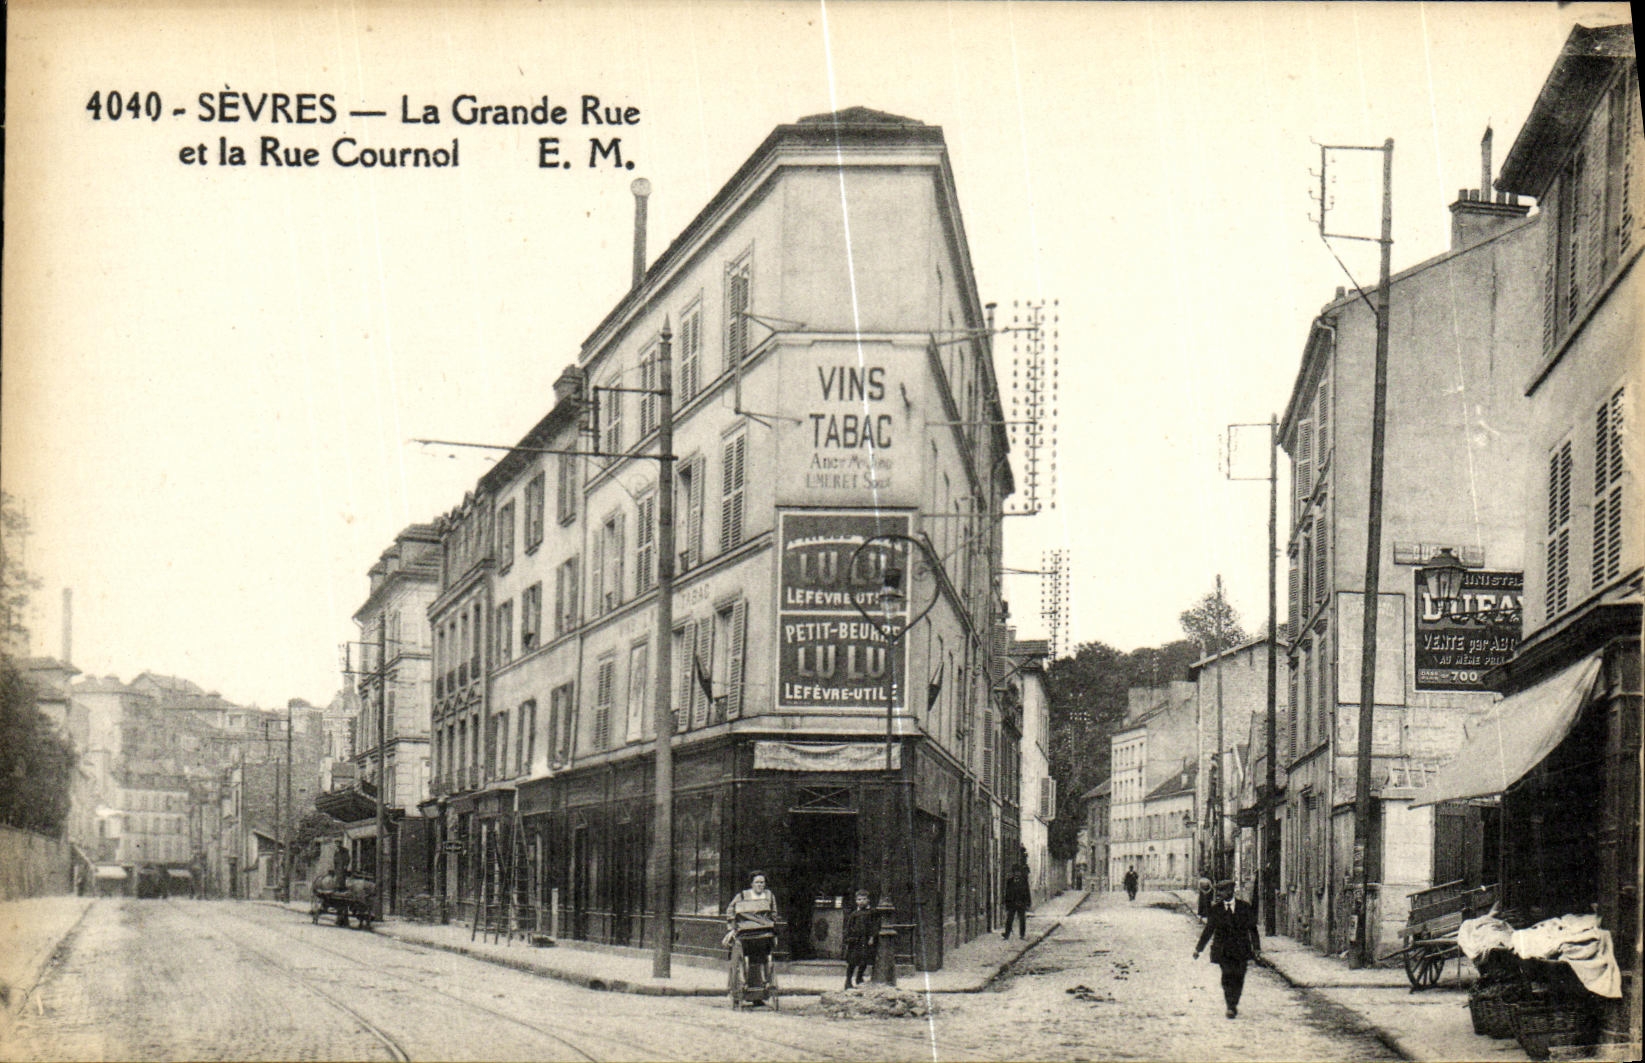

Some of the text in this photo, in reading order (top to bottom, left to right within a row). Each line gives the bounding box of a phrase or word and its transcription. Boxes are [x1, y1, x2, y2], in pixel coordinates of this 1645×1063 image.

[818, 366, 885, 401] VINS
[809, 413, 892, 449] TABAC
[1424, 633, 1465, 651] VENTE
[797, 644, 886, 680] LU LU
[1450, 671, 1478, 682] 700
